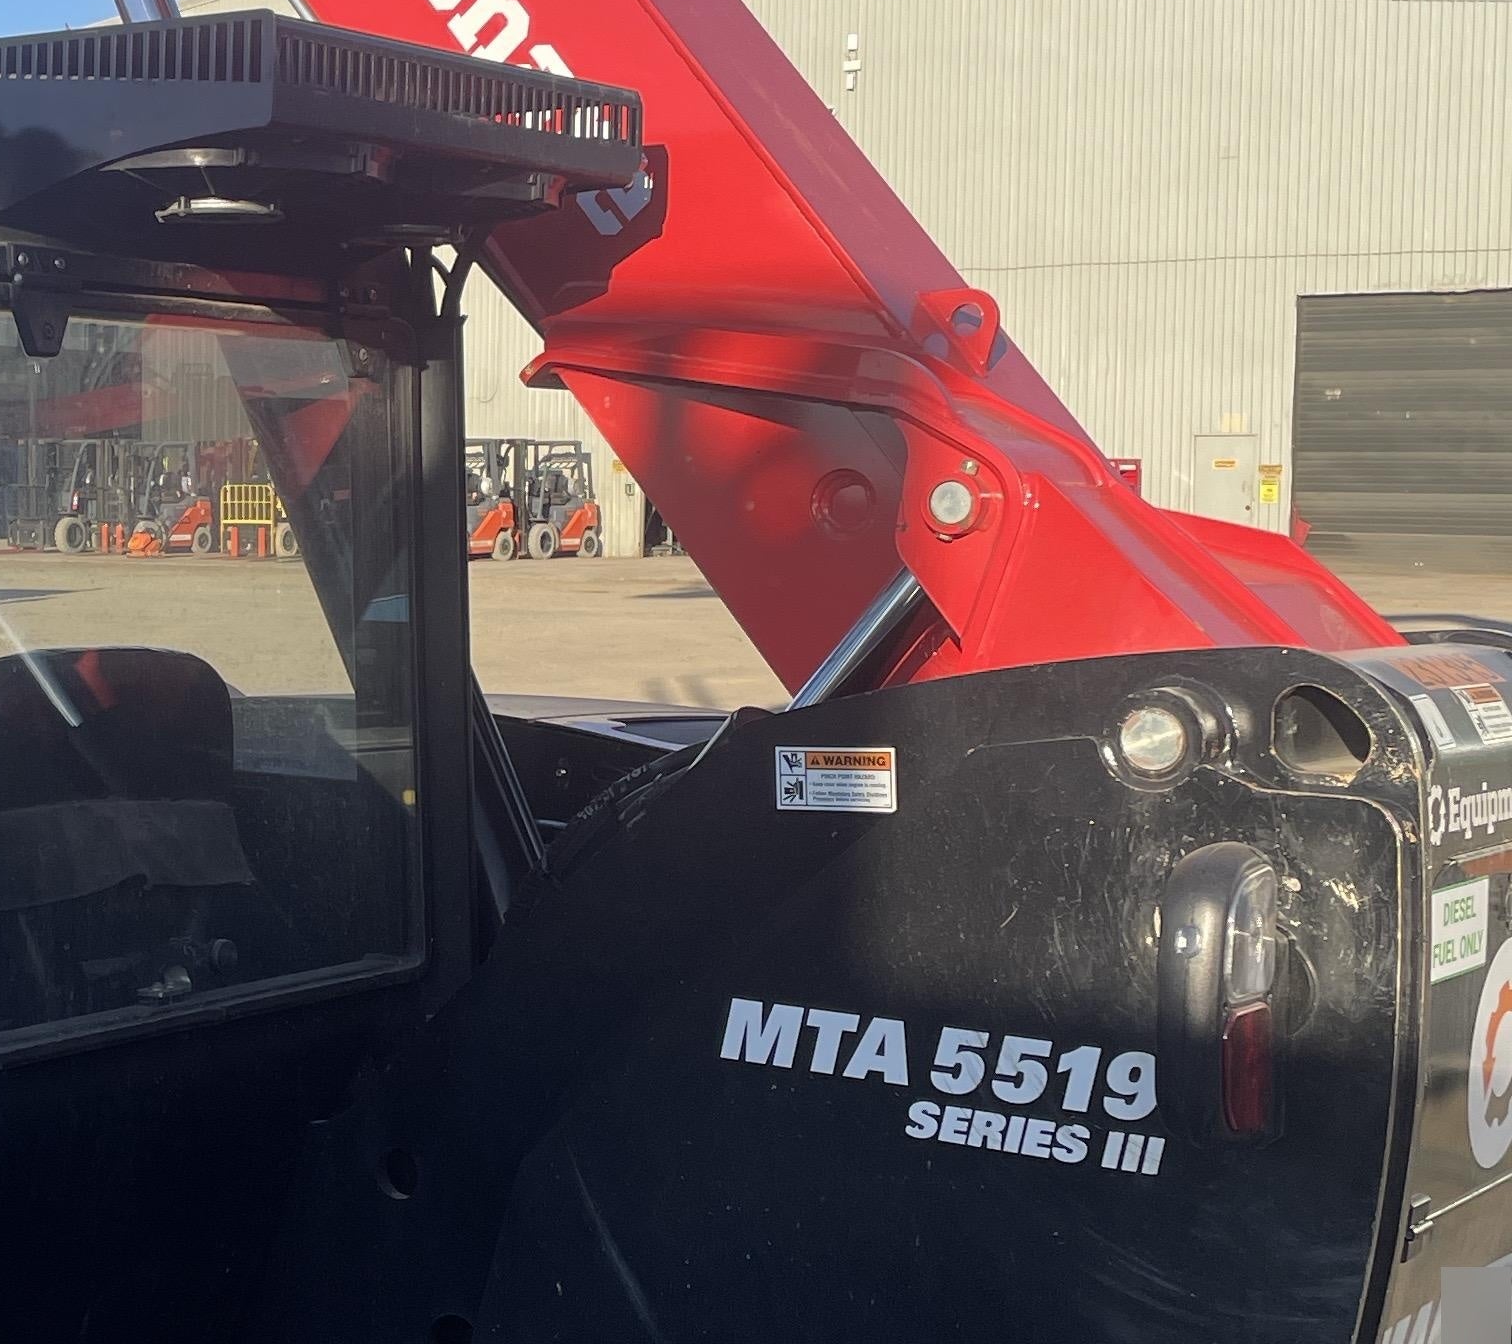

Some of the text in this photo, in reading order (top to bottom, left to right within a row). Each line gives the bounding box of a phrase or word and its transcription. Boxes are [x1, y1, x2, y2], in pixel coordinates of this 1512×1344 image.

[822, 755, 886, 766] WARNING
[1443, 895, 1476, 927] DIESEL
[1433, 928, 1484, 969] FUEL ONLY
[720, 997, 1157, 1121] MTA 5519
[905, 1101, 1166, 1176] SERIES III
